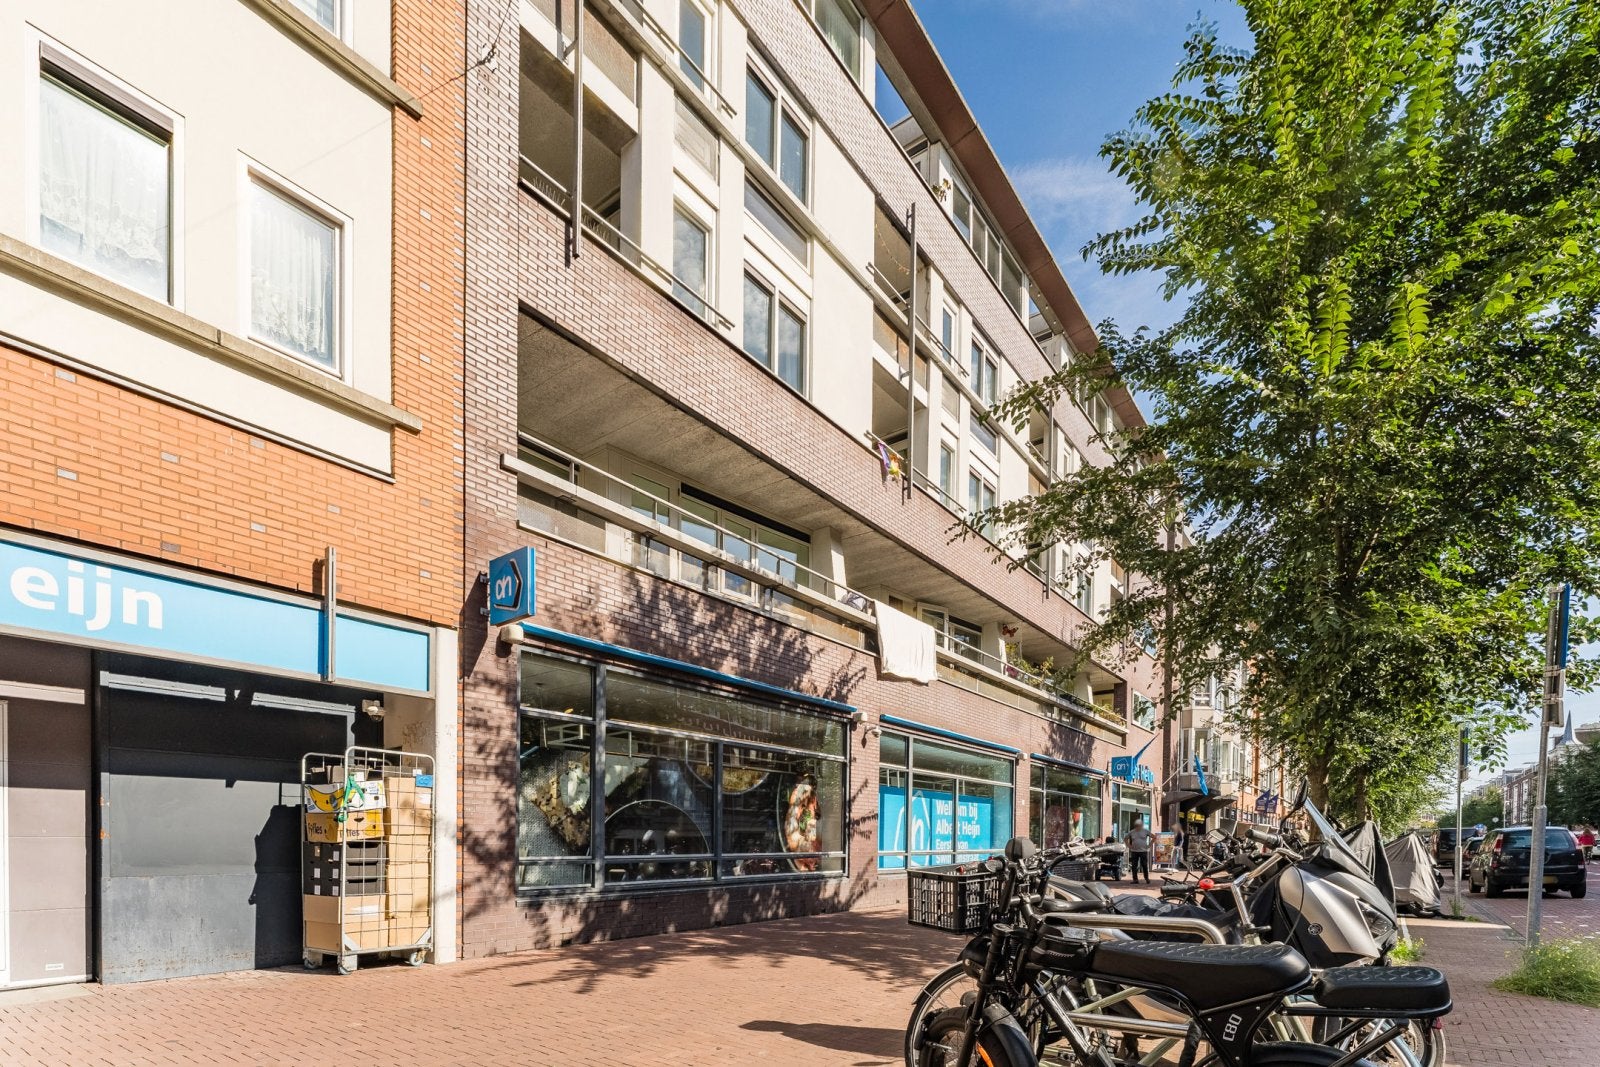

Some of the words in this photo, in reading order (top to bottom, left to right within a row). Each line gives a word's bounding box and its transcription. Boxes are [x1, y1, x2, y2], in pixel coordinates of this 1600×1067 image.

[969, 802, 978, 821] bij
[936, 818, 960, 835] Albet
[962, 820, 980, 838] Heijn
[1223, 1014, 1242, 1041] C80
